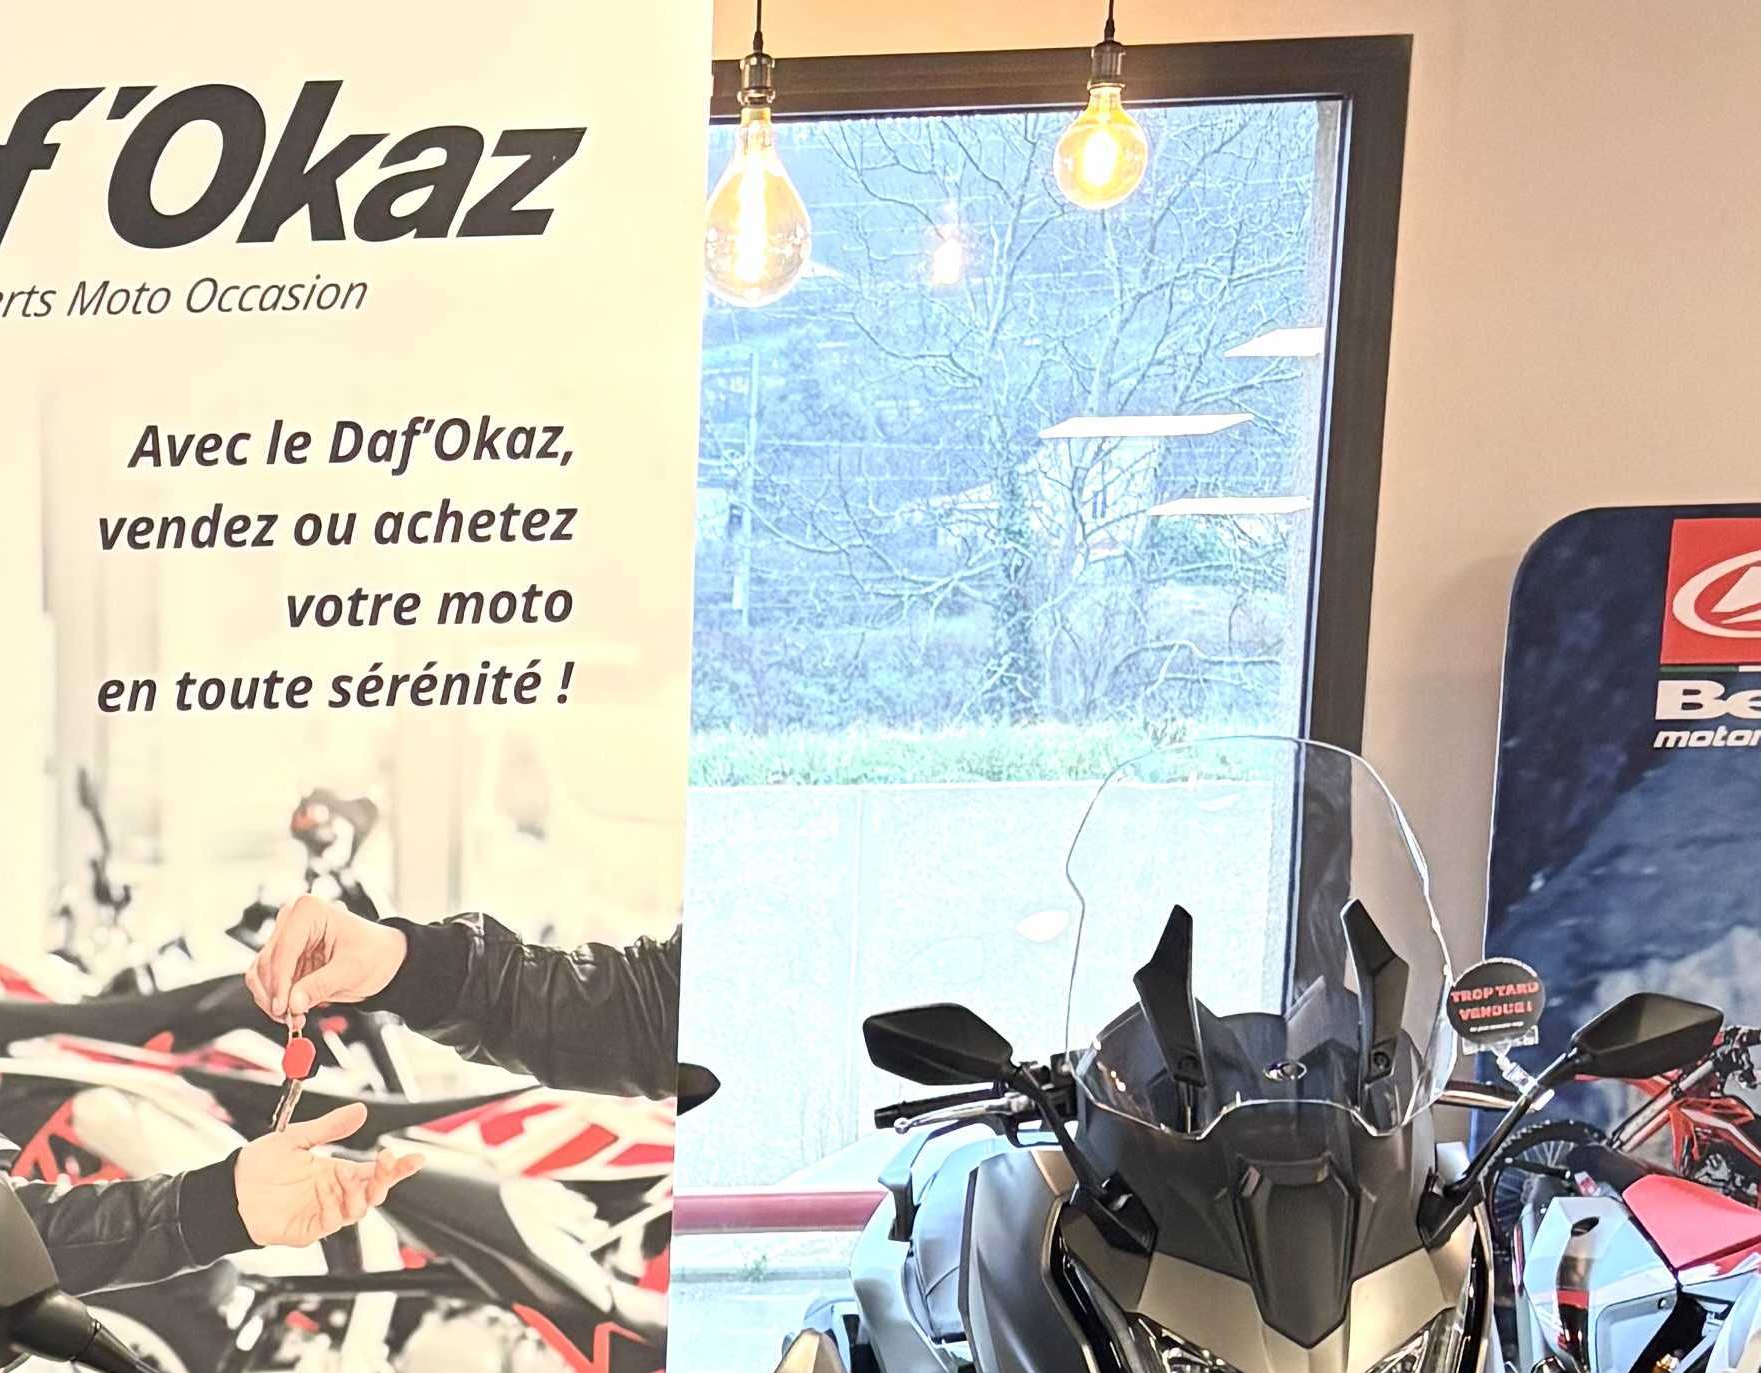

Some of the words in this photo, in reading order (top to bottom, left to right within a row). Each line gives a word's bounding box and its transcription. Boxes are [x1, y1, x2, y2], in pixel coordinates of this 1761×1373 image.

[67, 281, 171, 316] Moto
[187, 274, 367, 313] Occasion
[128, 425, 251, 467] Avec
[267, 420, 311, 464] le
[100, 503, 278, 550] vendez
[294, 513, 356, 546] ou
[375, 498, 577, 544] achetez
[288, 588, 421, 627] votre
[438, 584, 572, 624] moto
[98, 680, 156, 712] en
[176, 671, 312, 711] toute
[329, 659, 541, 708] sérénité
[1451, 986, 1494, 1003] TROP
[1495, 982, 1539, 997] TARD
[1459, 1002, 1525, 1021] VENDUE
